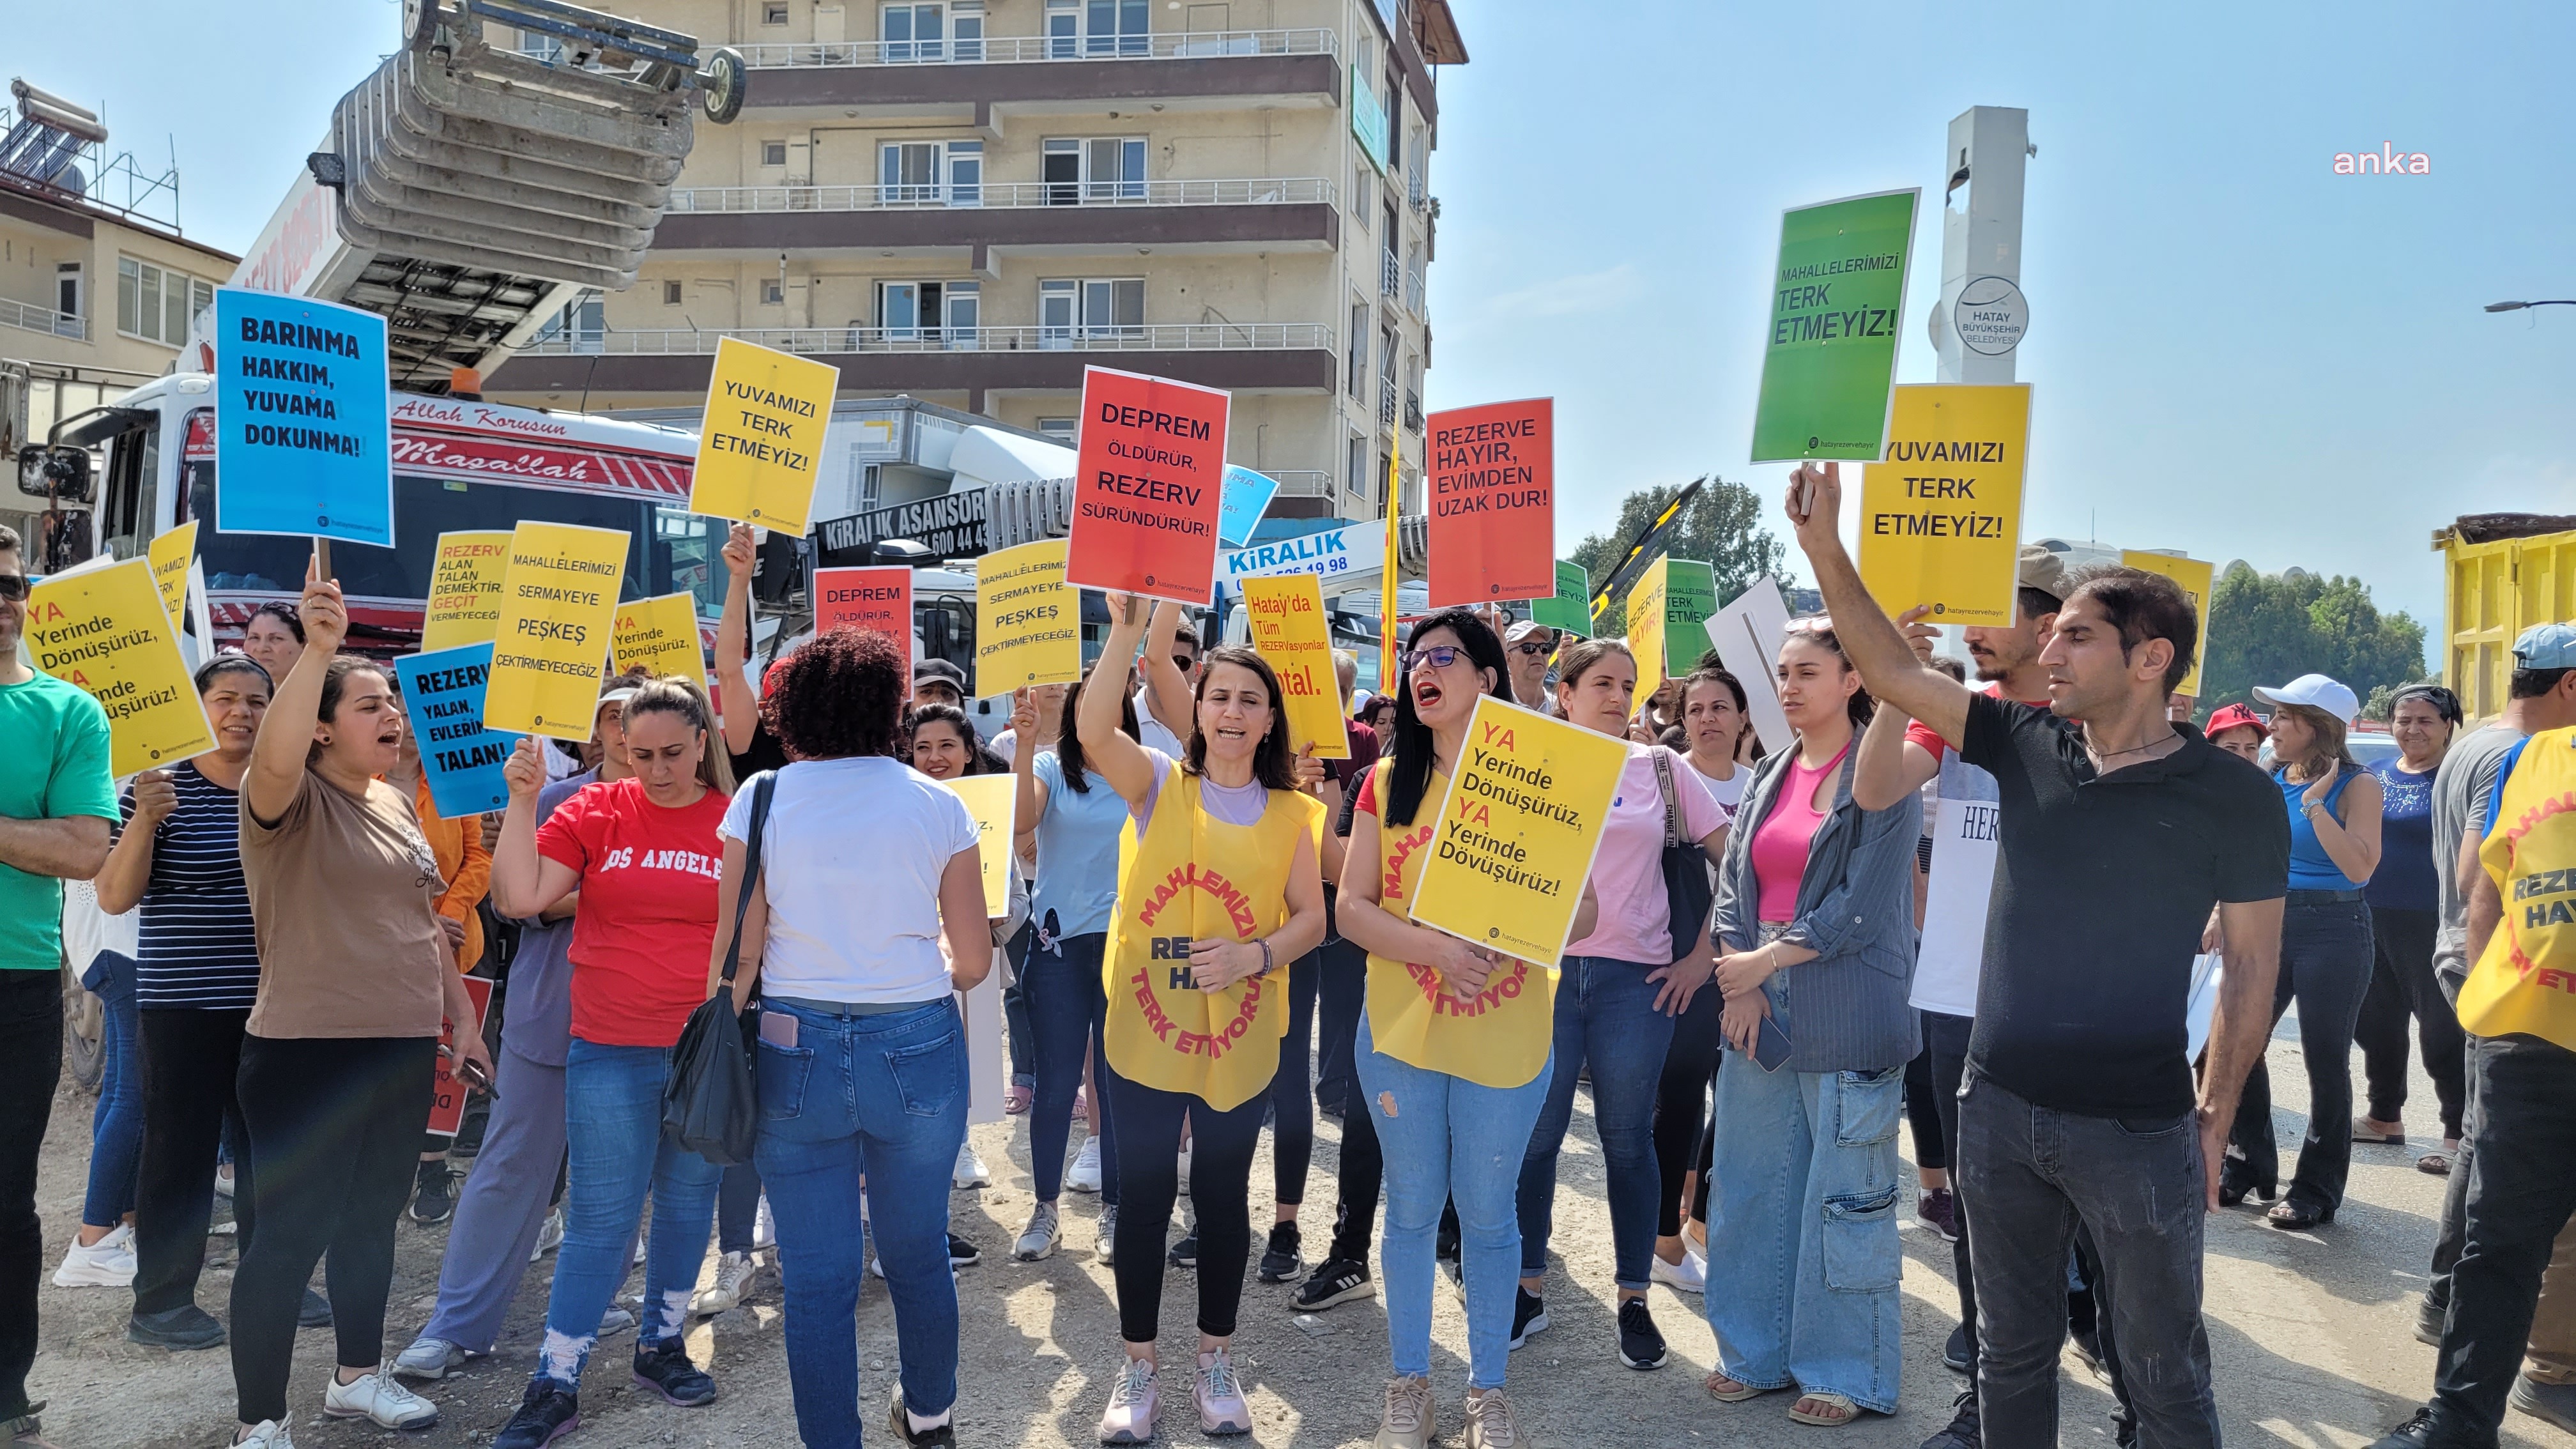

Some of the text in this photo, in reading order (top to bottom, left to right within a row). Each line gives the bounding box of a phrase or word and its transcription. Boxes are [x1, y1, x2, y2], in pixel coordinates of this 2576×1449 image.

[1781, 252, 1899, 282] MAHALLELERİMİZİ
[1779, 282, 1832, 312] TERK
[1774, 304, 1896, 344] ETMEYİZ!
[1963, 323, 2020, 335] BÜYÜKŞEHİR
[1974, 311, 2011, 322] HATAY
[241, 317, 360, 360] BARINMA
[242, 356, 334, 390] HAKKIM,
[243, 390, 336, 420] YUVAMA
[725, 379, 816, 418] YUVAMIZI
[393, 400, 567, 436] Allah Korusun
[740, 411, 794, 440] TERK
[1101, 402, 1210, 441] DEPREM
[245, 424, 360, 457] DOKUNMA!
[1437, 419, 1535, 448] REZERVE
[712, 433, 809, 472] ETMEYİZ!
[1108, 439, 1197, 473] ÖLDÜRÜR,
[1438, 442, 1517, 470] HAYIR,
[1885, 441, 2004, 463] YUVAMIZI
[1097, 471, 1202, 507] REZERV
[1438, 466, 1532, 494] EVİMDEN
[1903, 477, 1976, 499] TERK
[898, 491, 986, 537] ASANSÖR
[1438, 489, 1547, 518] UZAK DUR!
[1081, 502, 1209, 537] SÜRÜNDÜRÜR!
[1874, 511, 2003, 539] ETMEYİZ!
[443, 545, 505, 558] REZERV
[932, 530, 954, 556] 600
[958, 526, 972, 551] 44
[153, 556, 185, 578] UVAMIZI
[438, 571, 479, 583] TALAN
[440, 559, 473, 571] ALAN
[513, 555, 617, 576] MAHALLELERİMİZİ
[981, 561, 1067, 586] MAHALLELERİMİ
[1329, 557, 1347, 572] 98
[433, 594, 479, 610] GEÇİT
[435, 581, 503, 595] DEMEKTİR.
[518, 585, 600, 606] SERMAYEYE
[827, 587, 900, 604] DEPREM
[990, 582, 1063, 604] SERMAYEYE
[1666, 597, 1694, 608] TERK
[27, 601, 65, 625] YA
[431, 611, 500, 622] VERMEYECEĞİ
[996, 604, 1059, 629] PEŞKEŞ
[1629, 583, 1664, 633] REZERVE
[32, 616, 114, 647] Yerinde
[517, 618, 587, 646] PEŞKEŞ
[615, 617, 636, 631] YA
[615, 628, 664, 645] Yerinde
[1256, 620, 1280, 636] Tüm
[1630, 608, 1660, 652] HAYIR!
[41, 629, 158, 670] Dönüşürüz,
[618, 639, 689, 660] Dönüşürüz,
[1261, 640, 1325, 652] REZERVasyonlar
[61, 670, 90, 686] A
[417, 662, 491, 695] REZERV
[422, 699, 474, 719] YALAN,
[1483, 720, 1515, 752] YA
[435, 742, 508, 772] TALAN!
[1474, 747, 1552, 790] Yerinde
[1459, 796, 1489, 828] YA
[1462, 771, 1583, 832] Dönüşürüz,
[1448, 819, 1526, 863] Yerinde
[641, 849, 723, 880] ANGELE
[1439, 841, 1561, 897] Dövüşürüz!
[1131, 967, 1177, 1043] TERK
